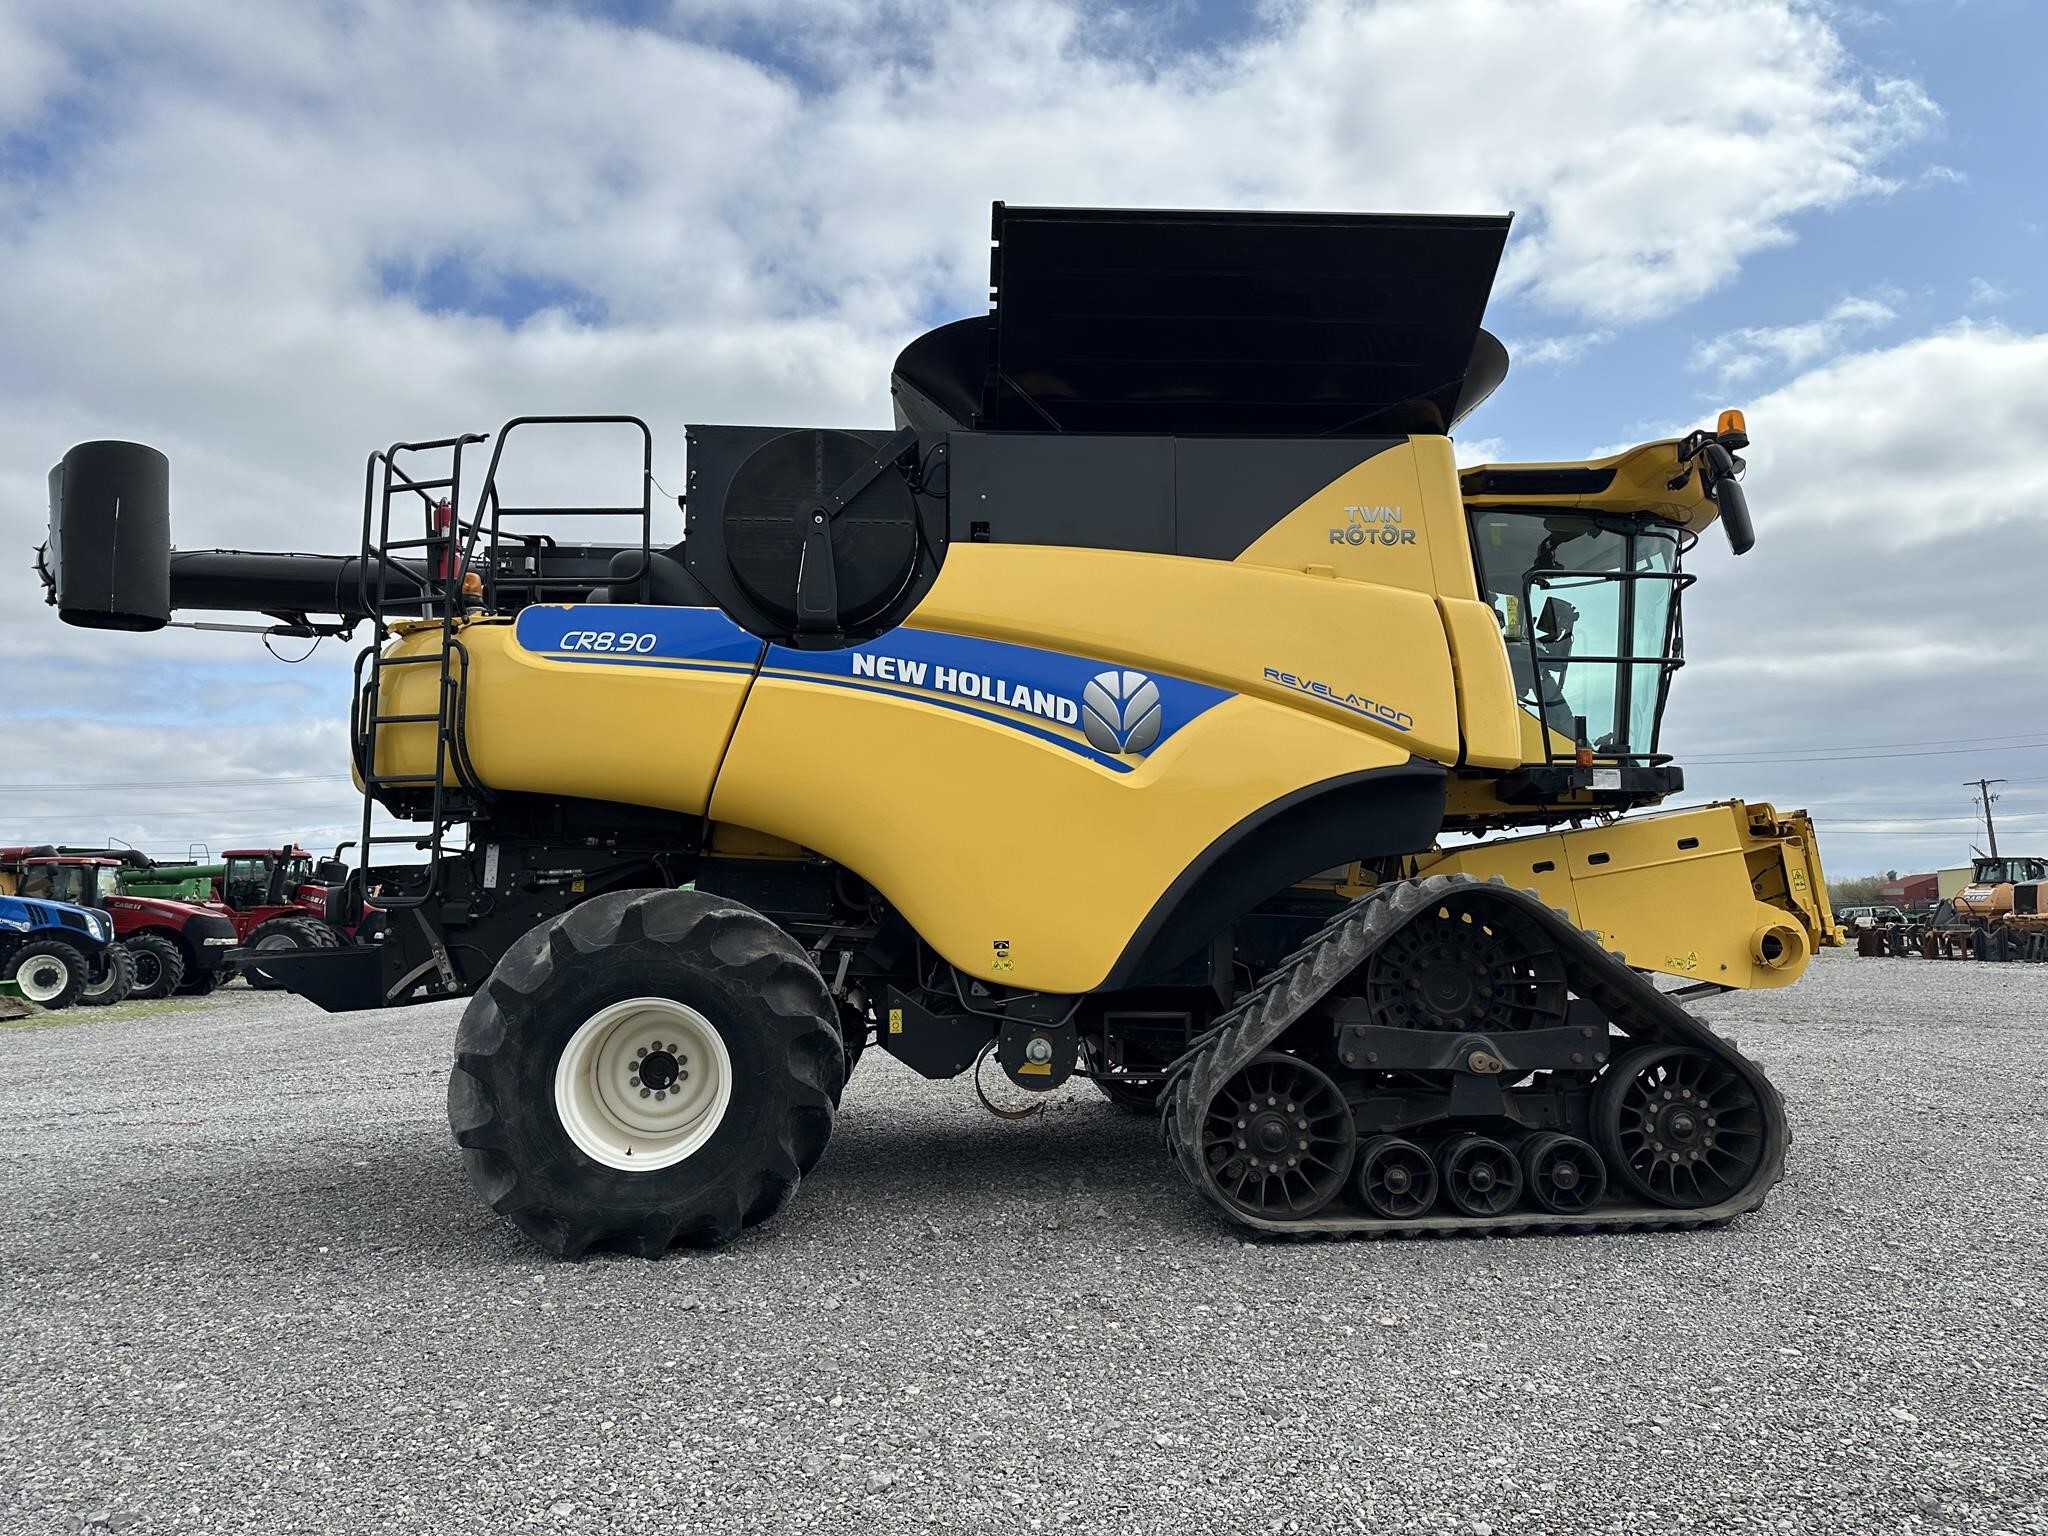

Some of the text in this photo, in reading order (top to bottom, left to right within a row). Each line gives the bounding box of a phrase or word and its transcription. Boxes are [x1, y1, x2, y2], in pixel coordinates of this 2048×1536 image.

[1344, 506, 1402, 523] TWIN
[1329, 525, 1416, 545] ROTOR
[559, 631, 656, 653] CR8.90
[852, 653, 1079, 725] NEW HOLLAND
[1264, 667, 1414, 727] REVELATION
